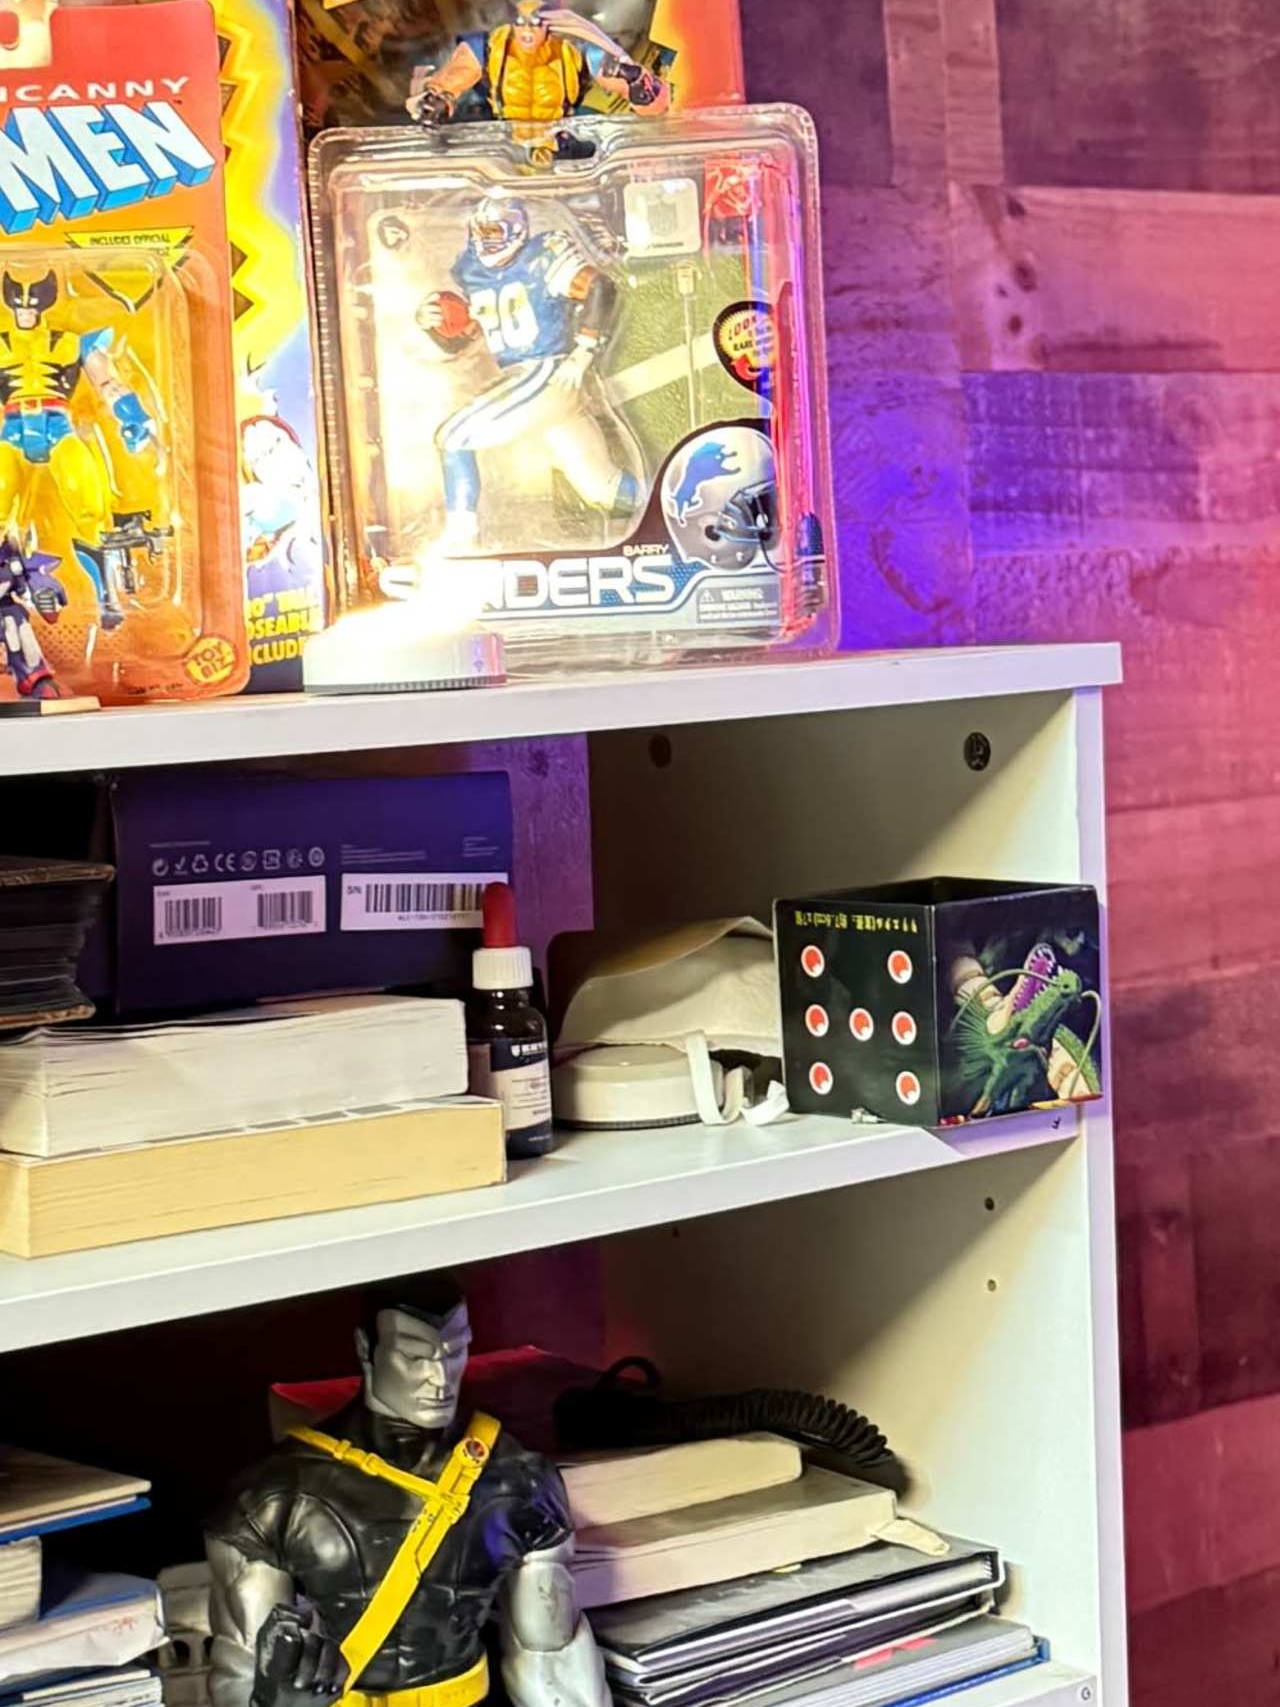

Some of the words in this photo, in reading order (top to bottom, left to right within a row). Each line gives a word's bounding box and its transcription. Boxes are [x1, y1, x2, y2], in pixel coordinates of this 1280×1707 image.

[469, 281, 540, 355] 20
[622, 543, 670, 558] BARRY
[379, 556, 679, 612] SDERS
[192, 641, 228, 666] TOY
